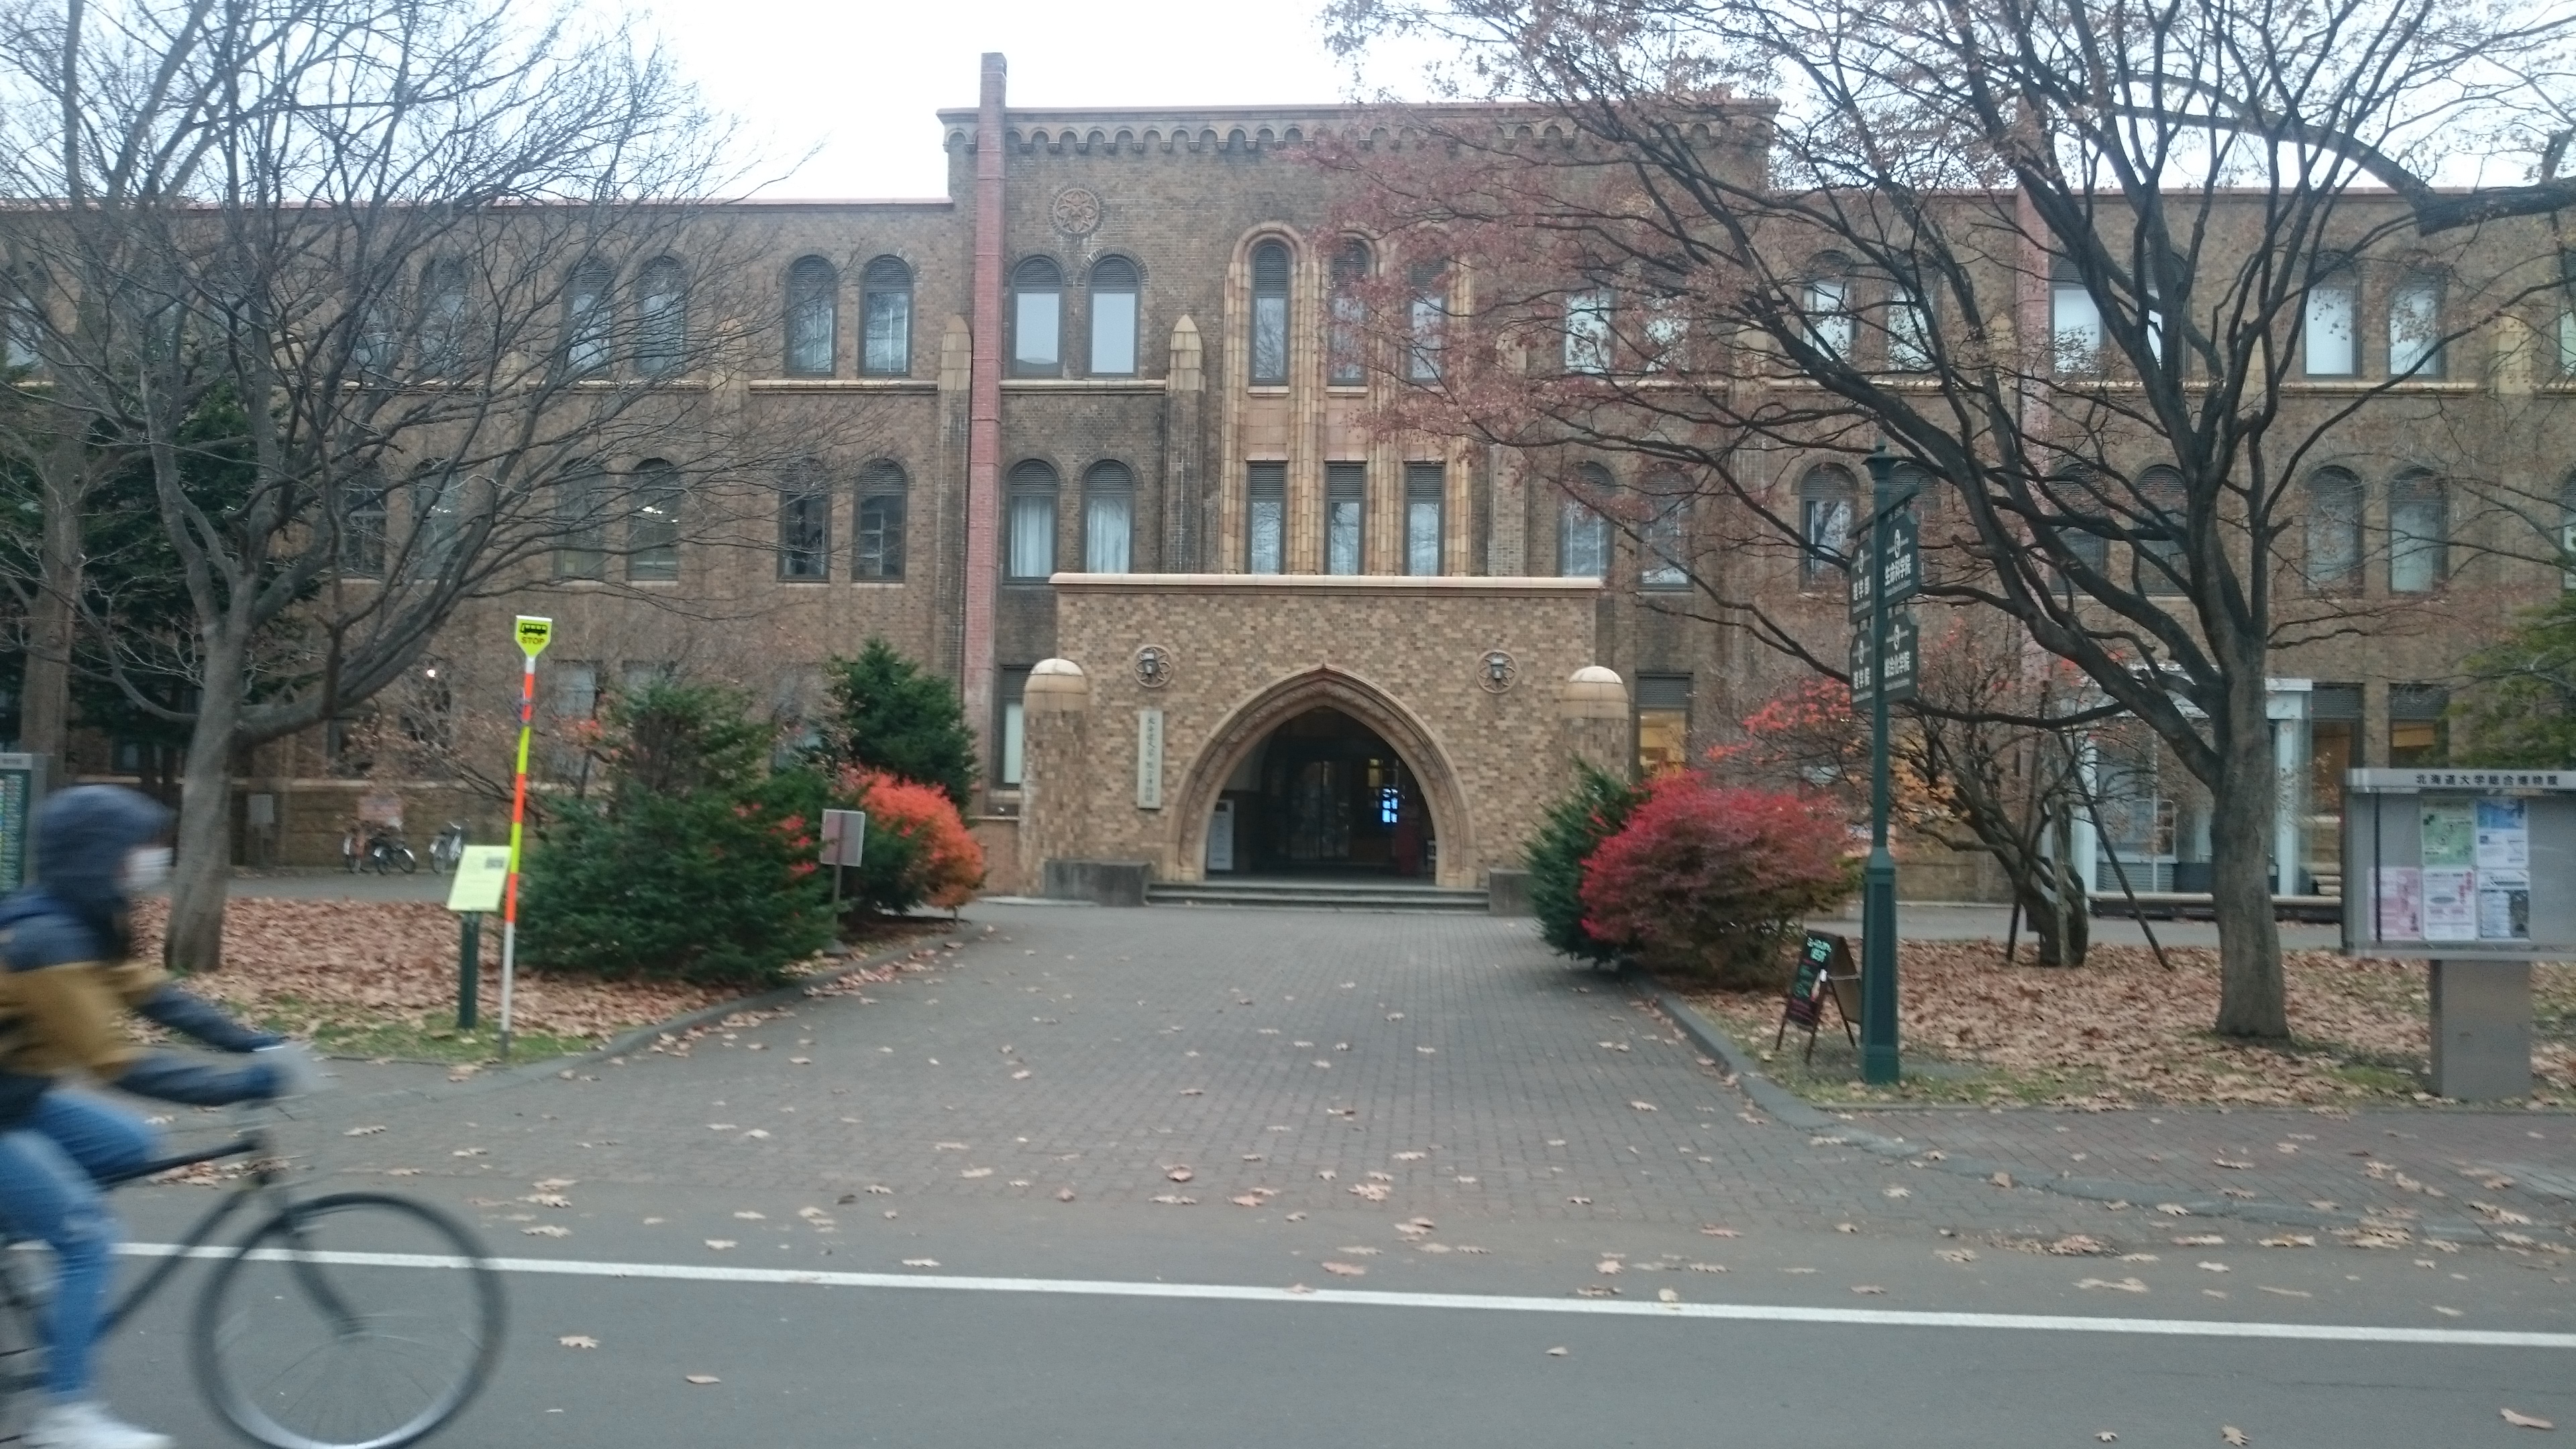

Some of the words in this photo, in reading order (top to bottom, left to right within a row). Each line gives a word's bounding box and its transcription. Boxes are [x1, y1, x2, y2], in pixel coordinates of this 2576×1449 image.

[1884, 553, 1911, 586] 生命科学院
[522, 637, 545, 645] STOP
